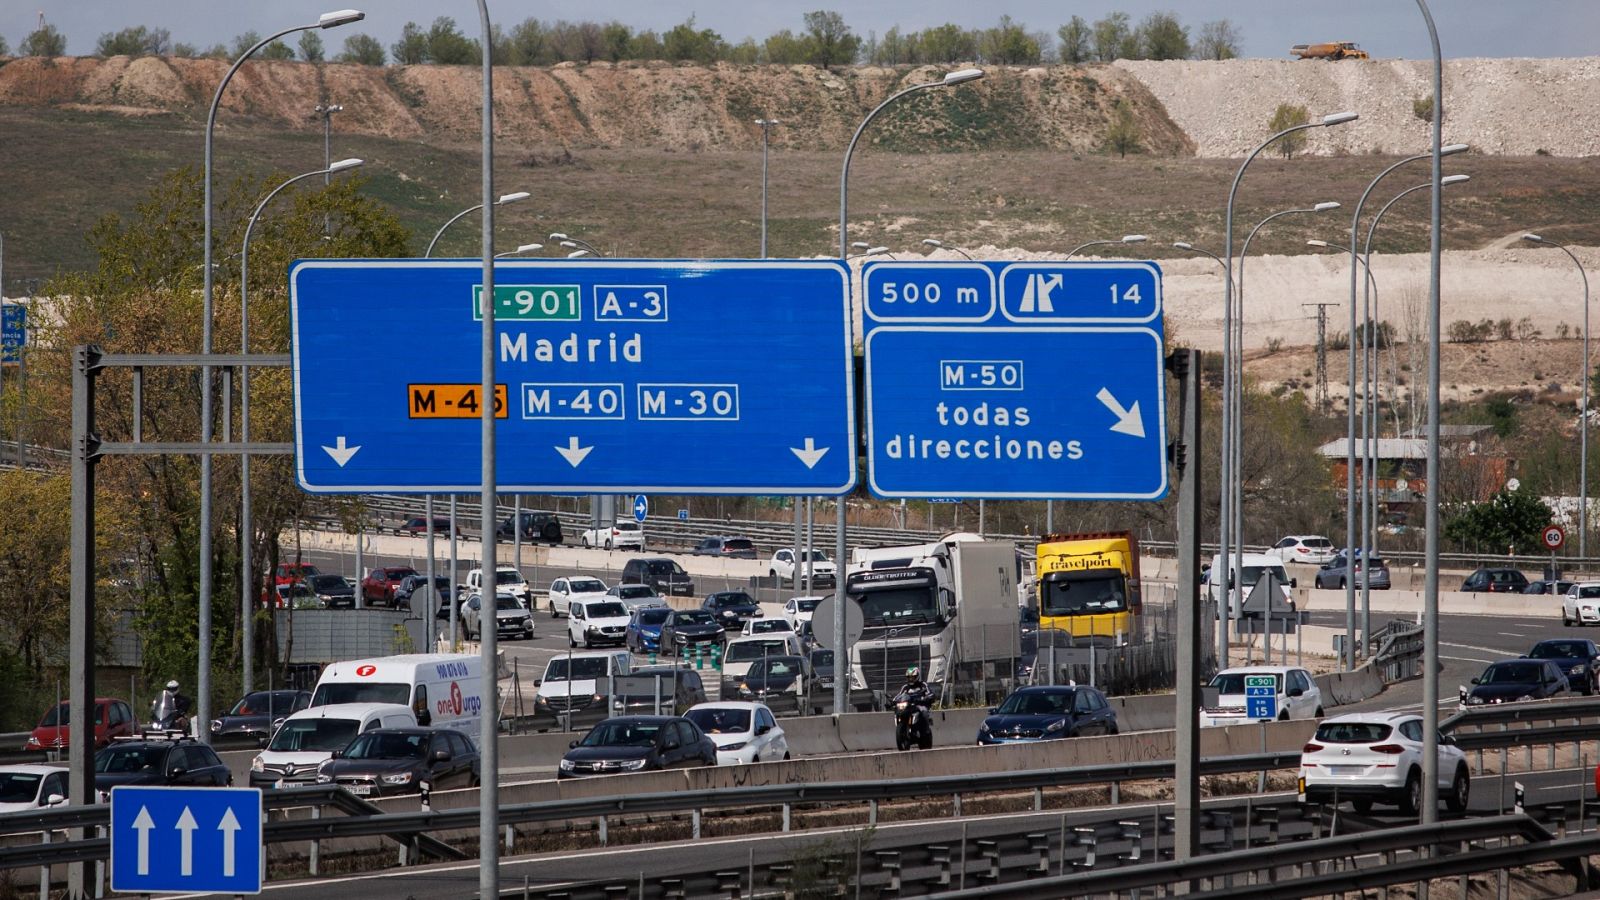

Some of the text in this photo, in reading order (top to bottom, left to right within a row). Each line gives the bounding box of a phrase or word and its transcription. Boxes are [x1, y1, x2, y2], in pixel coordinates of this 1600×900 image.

[600, 291, 662, 317] A-3
[881, 282, 979, 304] 500 m
[1109, 283, 1142, 304] 14
[500, 332, 642, 363] Madrid
[944, 365, 1018, 386] M-50
[527, 389, 618, 415] M-40
[643, 390, 733, 416] M-30
[936, 401, 1031, 427] todas
[886, 434, 1084, 460] direcciones
[1050, 558, 1111, 570] travelport
[1255, 707, 1268, 716] 15
